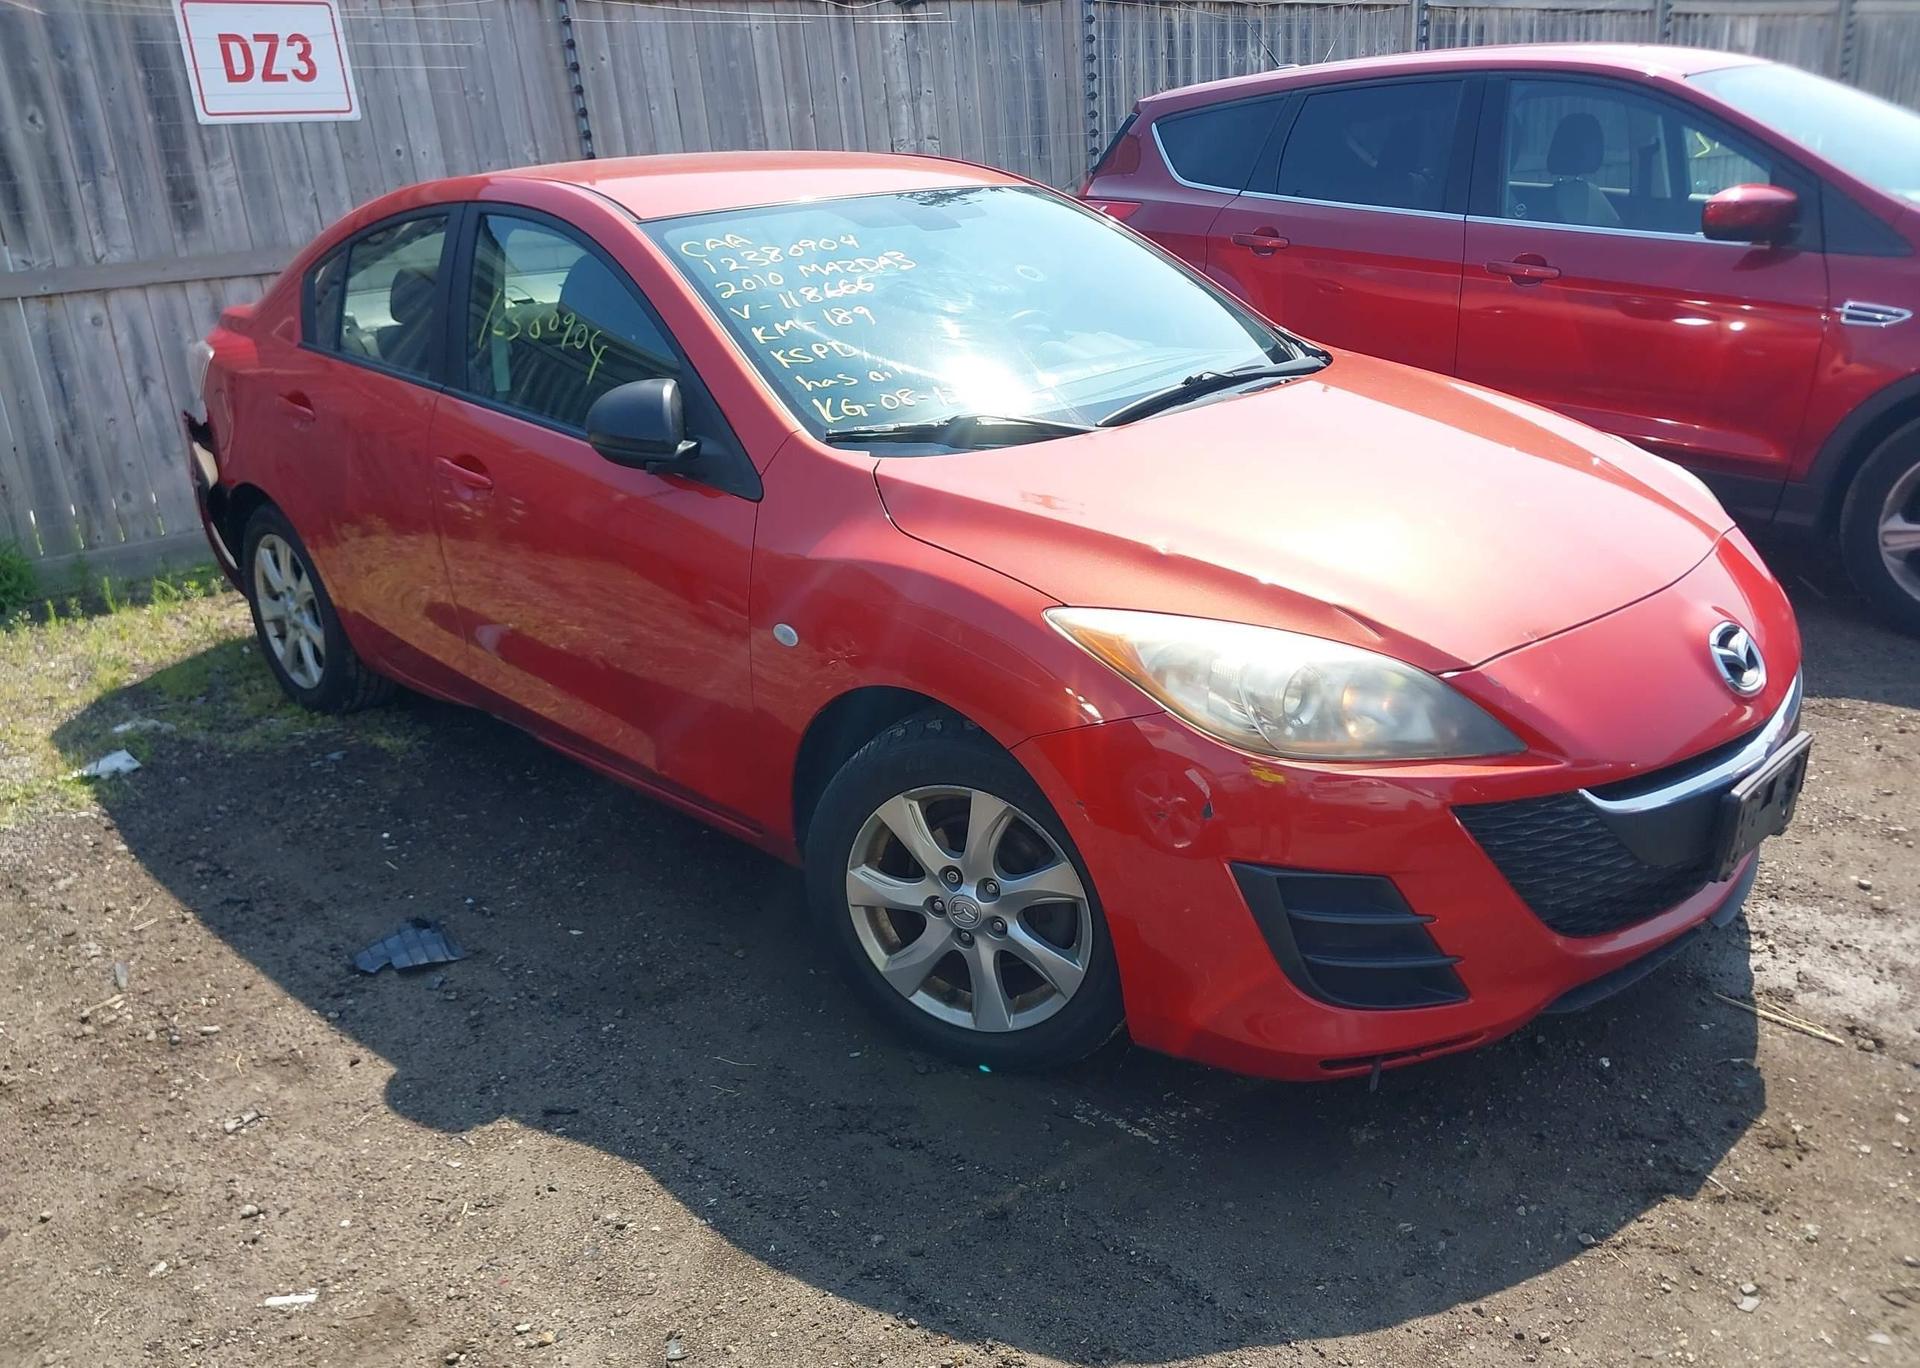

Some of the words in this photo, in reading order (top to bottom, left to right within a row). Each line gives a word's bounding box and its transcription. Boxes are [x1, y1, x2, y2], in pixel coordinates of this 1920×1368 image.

[218, 33, 317, 83] DZ3
[680, 232, 753, 258] CAA
[715, 272, 784, 299] 2010
